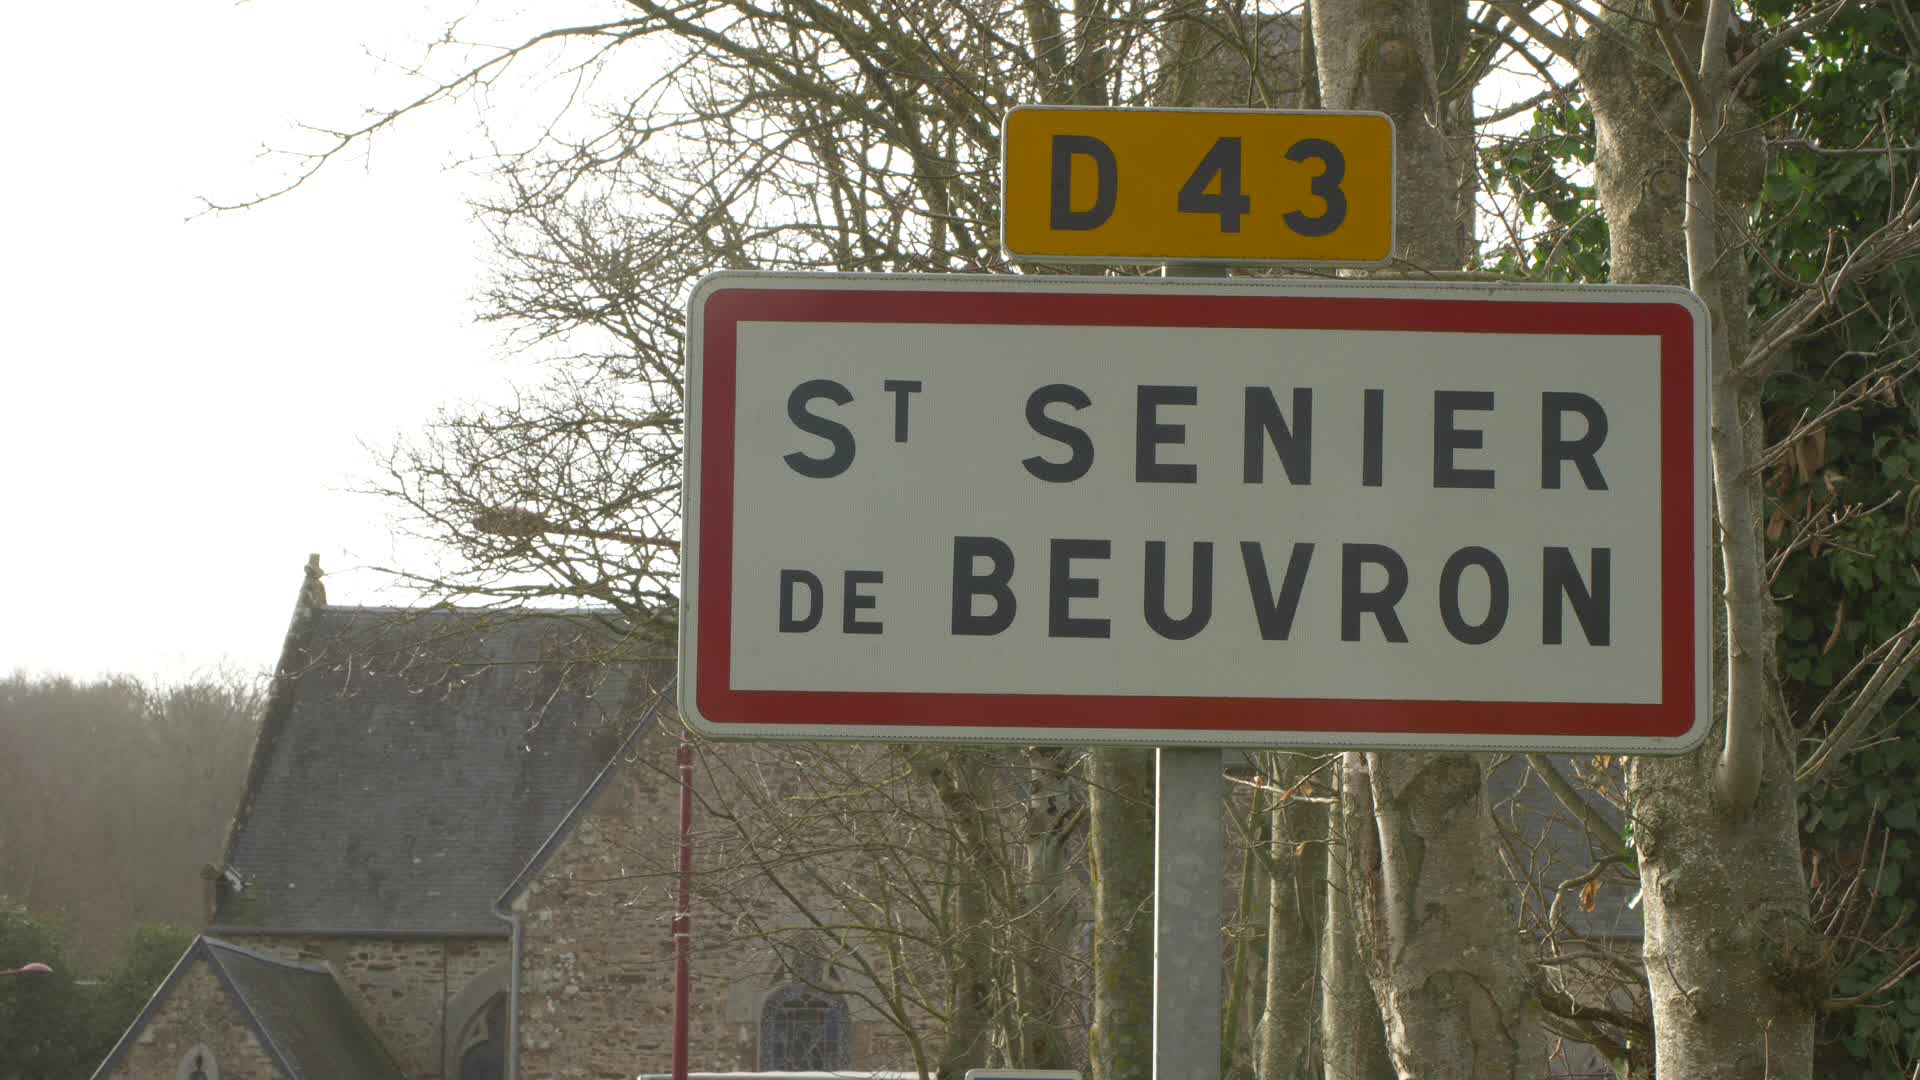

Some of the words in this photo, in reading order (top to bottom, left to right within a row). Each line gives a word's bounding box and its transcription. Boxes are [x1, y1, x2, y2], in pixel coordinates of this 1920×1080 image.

[1049, 133, 1118, 232] D
[1177, 135, 1349, 238] 43
[1021, 383, 1613, 492] SENIER
[778, 567, 885, 636] DE
[951, 535, 1613, 648] BEUVRON
